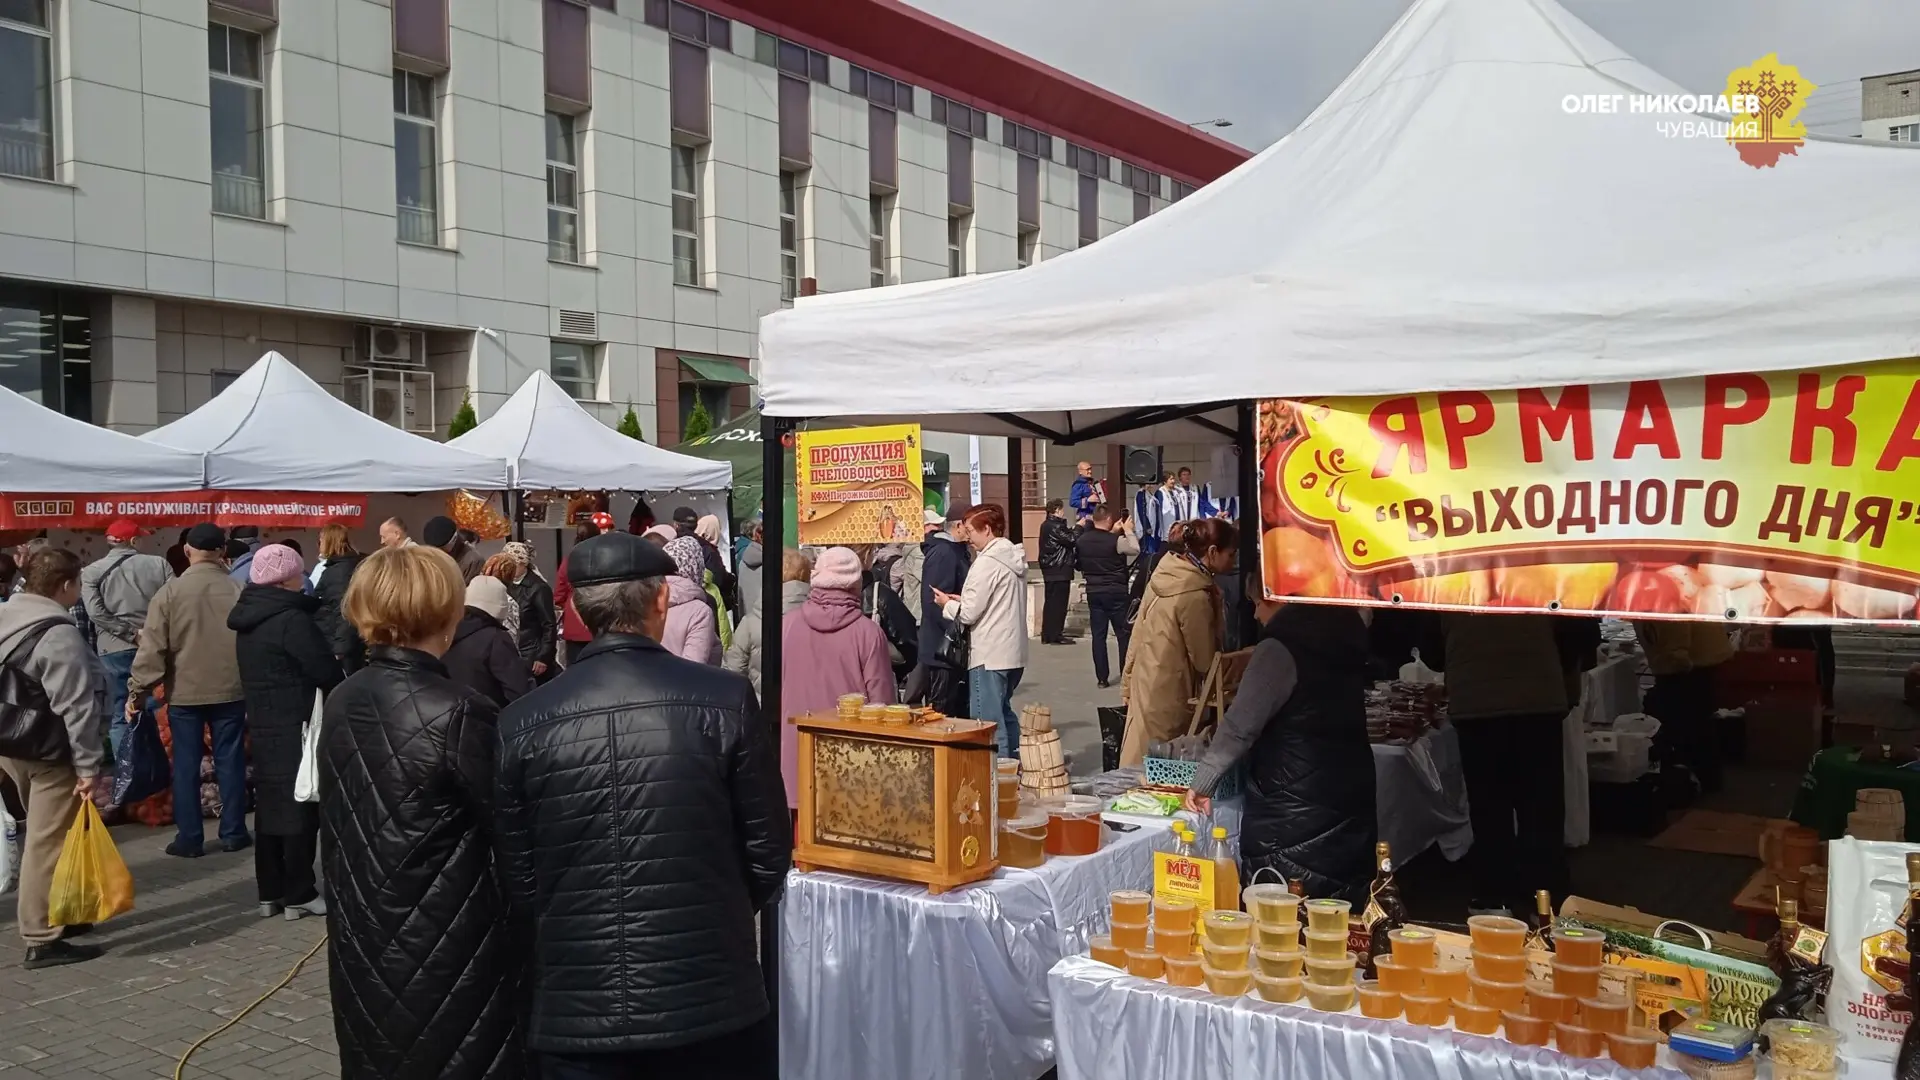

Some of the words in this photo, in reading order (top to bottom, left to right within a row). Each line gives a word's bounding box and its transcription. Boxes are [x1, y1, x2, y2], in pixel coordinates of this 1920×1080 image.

[710, 428, 763, 444] РСХ
[810, 441, 906, 465] ПРОДУКЦИЯ
[810, 463, 907, 483] ПЧЕЛОВОДСТВА
[811, 491, 828, 502] КФХ
[830, 488, 884, 502] Пирожковой
[86, 501, 113, 515] ВАС
[117, 501, 212, 516] ОБСЛУЖИВАЕТ
[214, 501, 326, 517] КРАСНОАРМЕЙСКОЕ
[328, 503, 361, 517] РАЙПО
[1166, 859, 1201, 882] МЁД
[1706, 974, 1771, 1006] ОТОВ
[1863, 993, 1887, 1008] НА
[1723, 1004, 1757, 1031] МЁ
